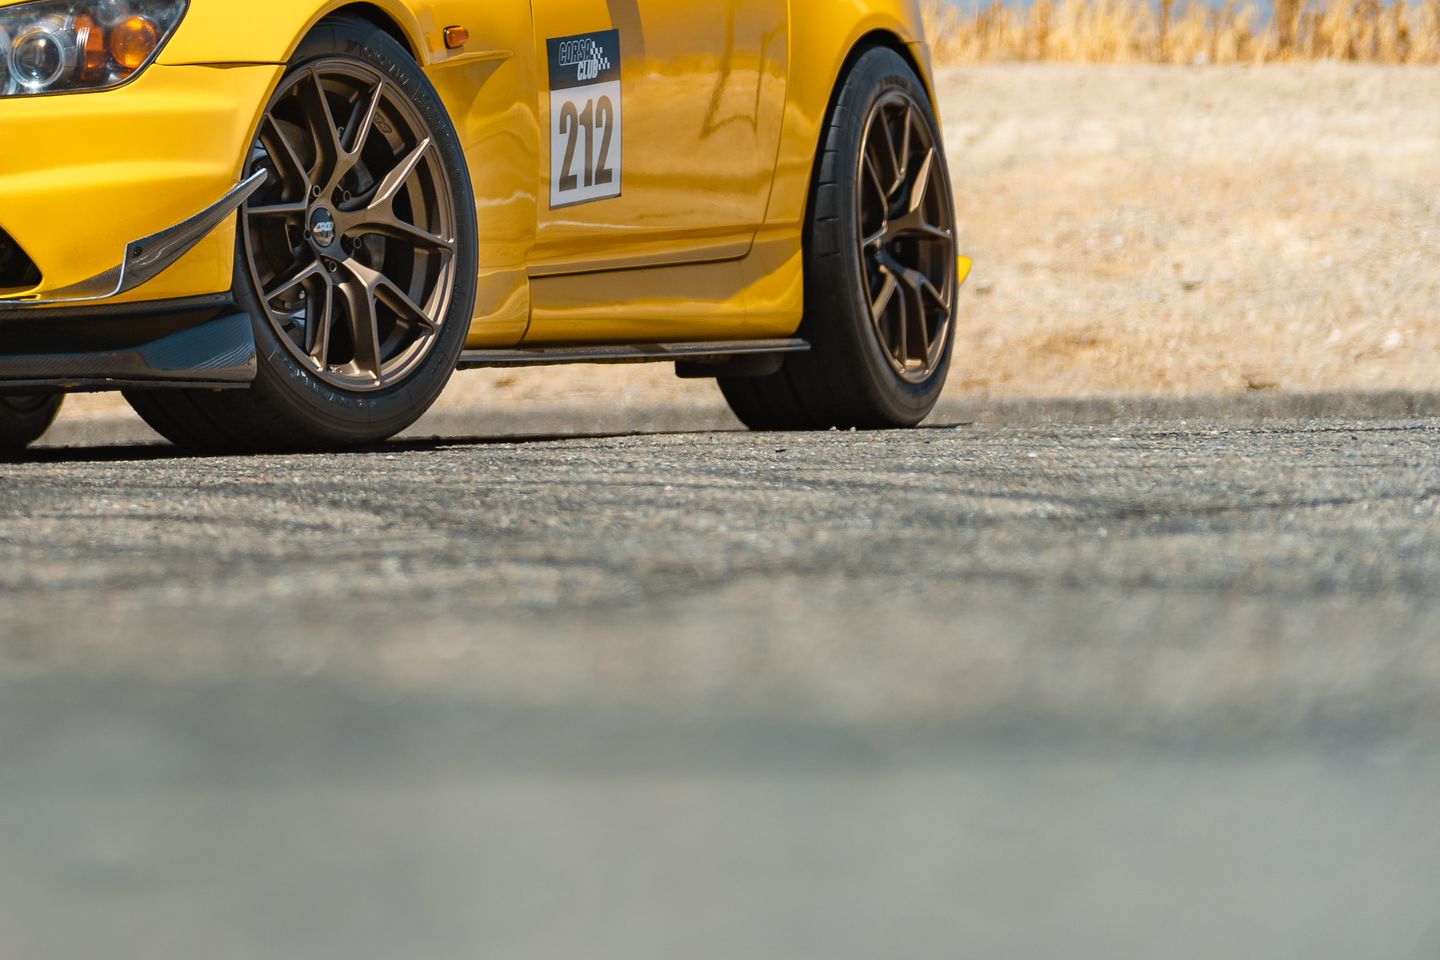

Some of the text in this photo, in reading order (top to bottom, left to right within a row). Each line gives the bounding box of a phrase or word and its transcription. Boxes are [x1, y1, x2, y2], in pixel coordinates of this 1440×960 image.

[559, 38, 591, 65] CORSA
[577, 59, 599, 80] CLUB
[559, 95, 614, 192] 212
